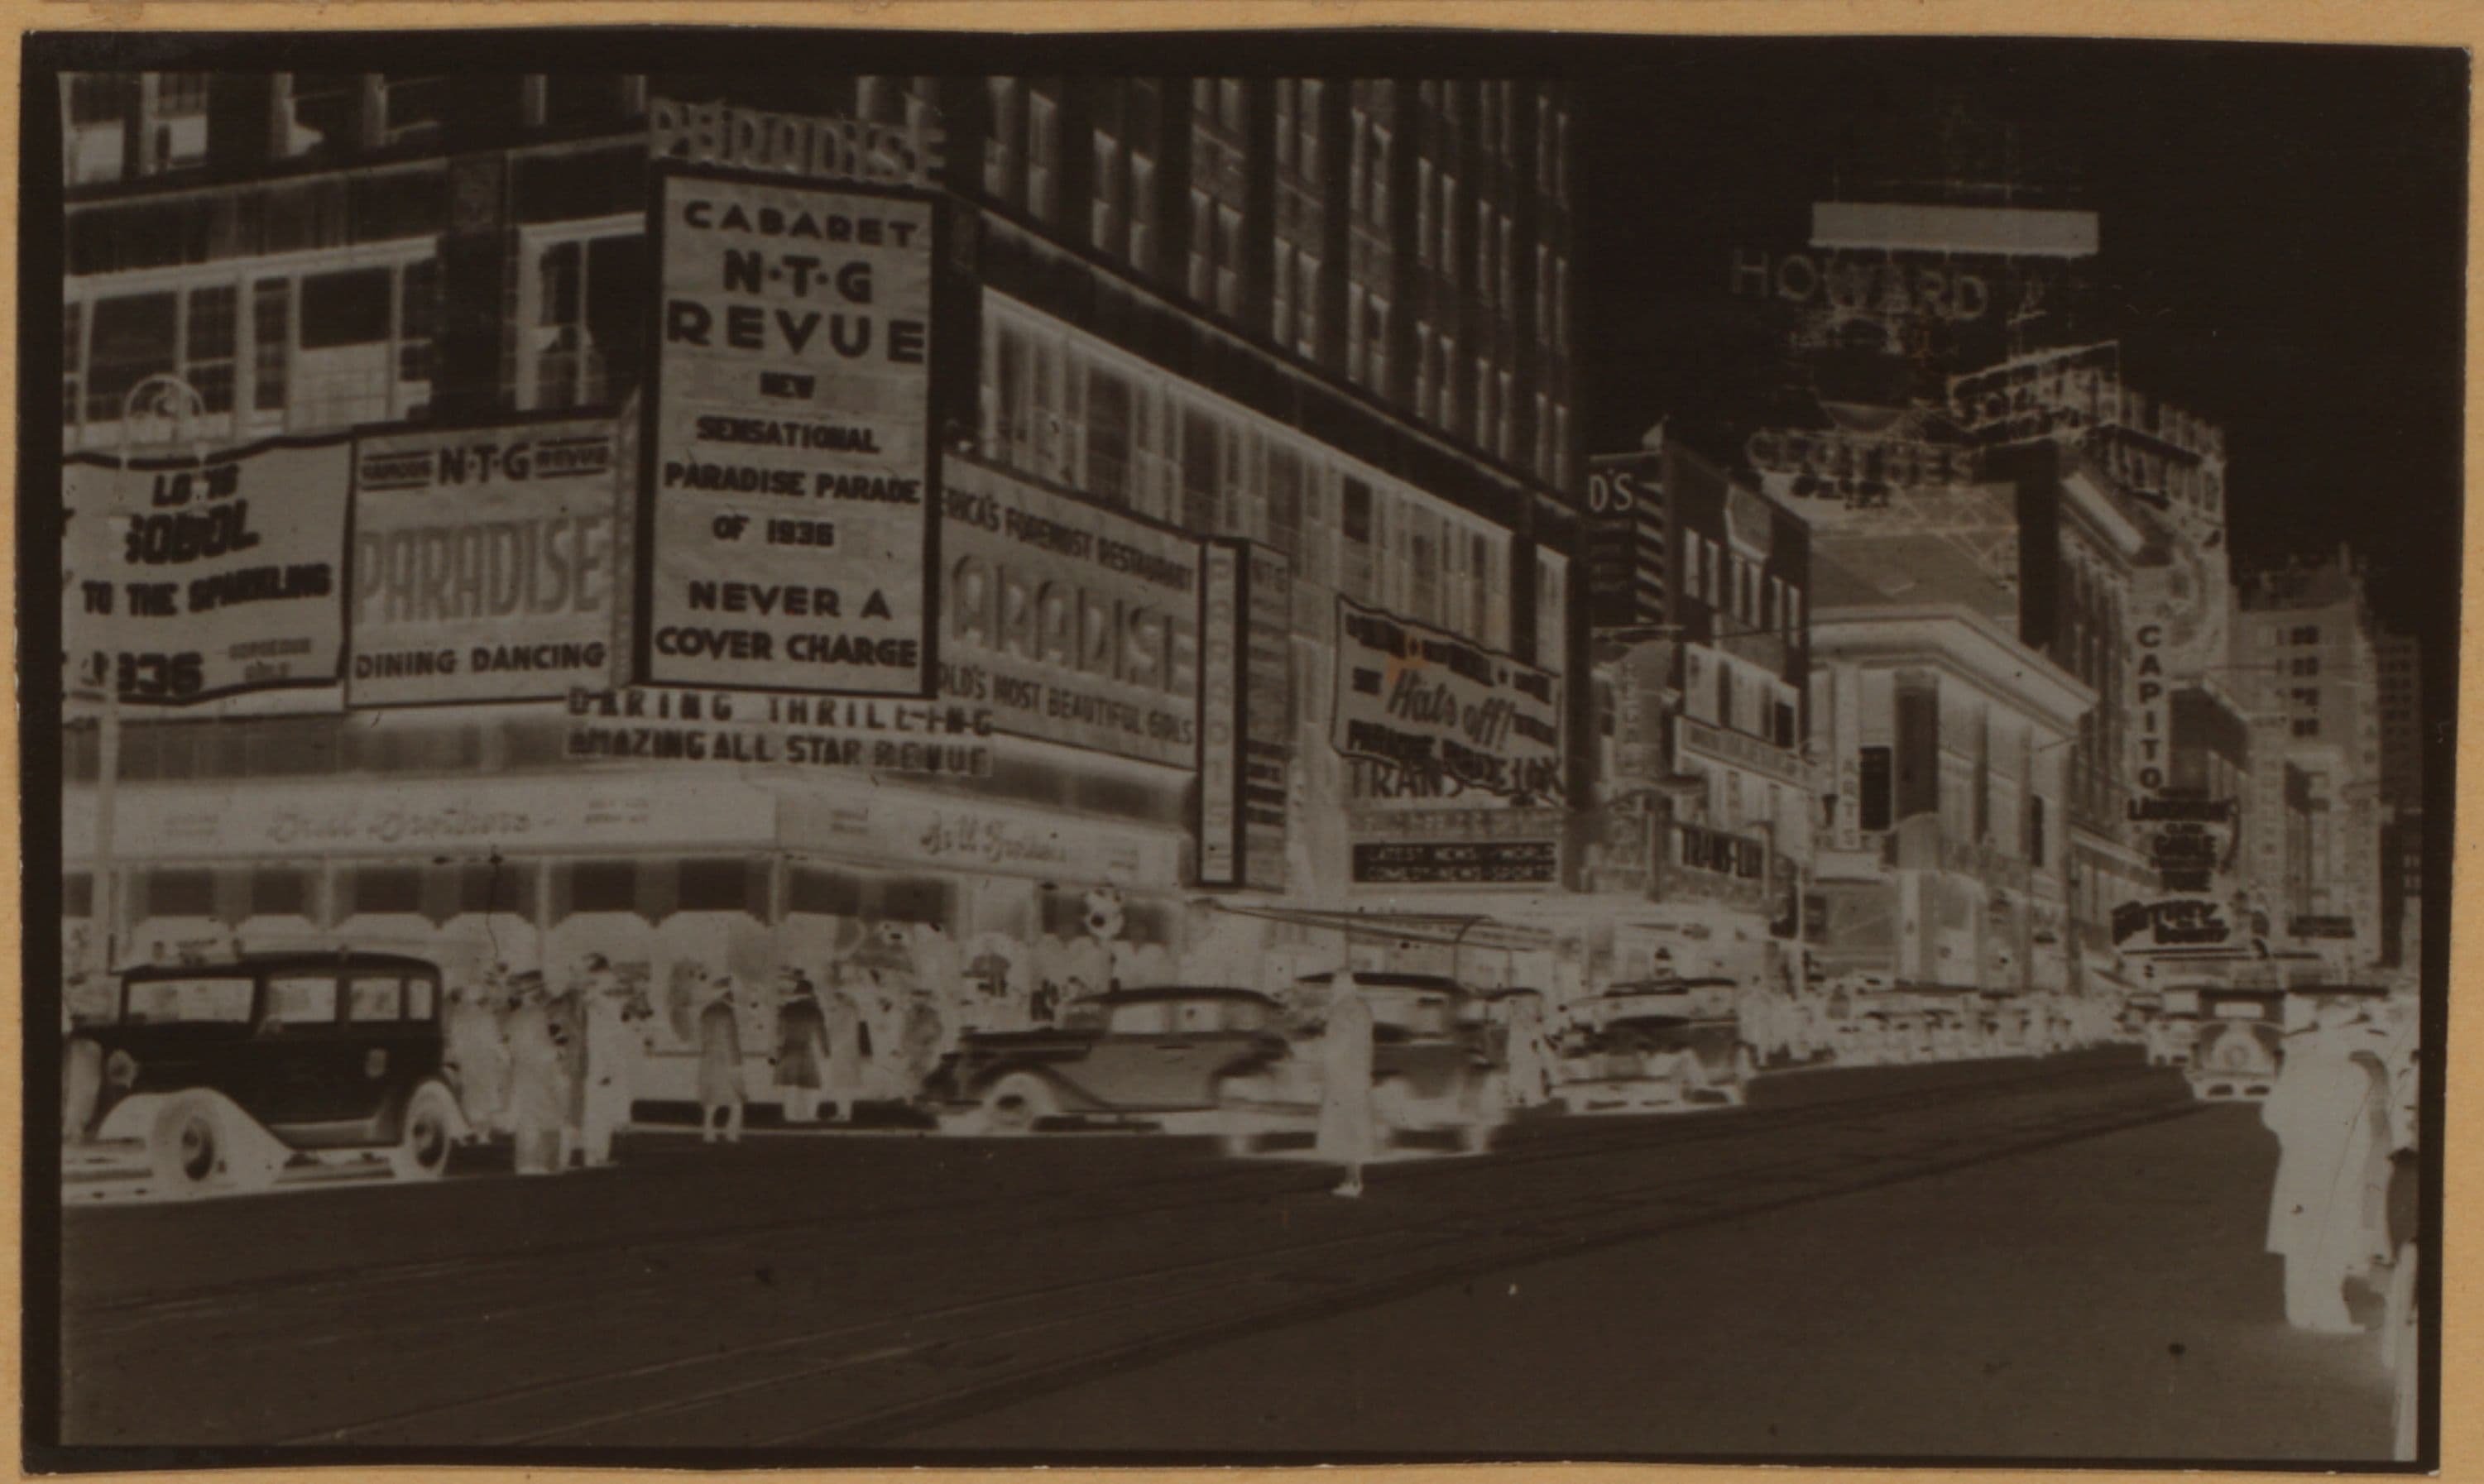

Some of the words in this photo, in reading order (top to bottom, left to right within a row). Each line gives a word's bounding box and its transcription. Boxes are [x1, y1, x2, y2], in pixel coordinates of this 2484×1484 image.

[683, 199, 918, 248] CABARET
[666, 298, 926, 366] REVUE
[696, 414, 882, 455] SENSATIONAL
[664, 461, 808, 498] PARADISE
[814, 472, 922, 505] PARADE
[712, 512, 751, 542] OF
[352, 515, 602, 622] PARADISE
[688, 580, 843, 618] NEVER
[859, 588, 894, 621] A
[353, 648, 458, 681] DINING
[469, 640, 607, 673] DANCING
[655, 625, 774, 662] COVER
[786, 633, 919, 669] CHARGE
[566, 685, 734, 722] DARING
